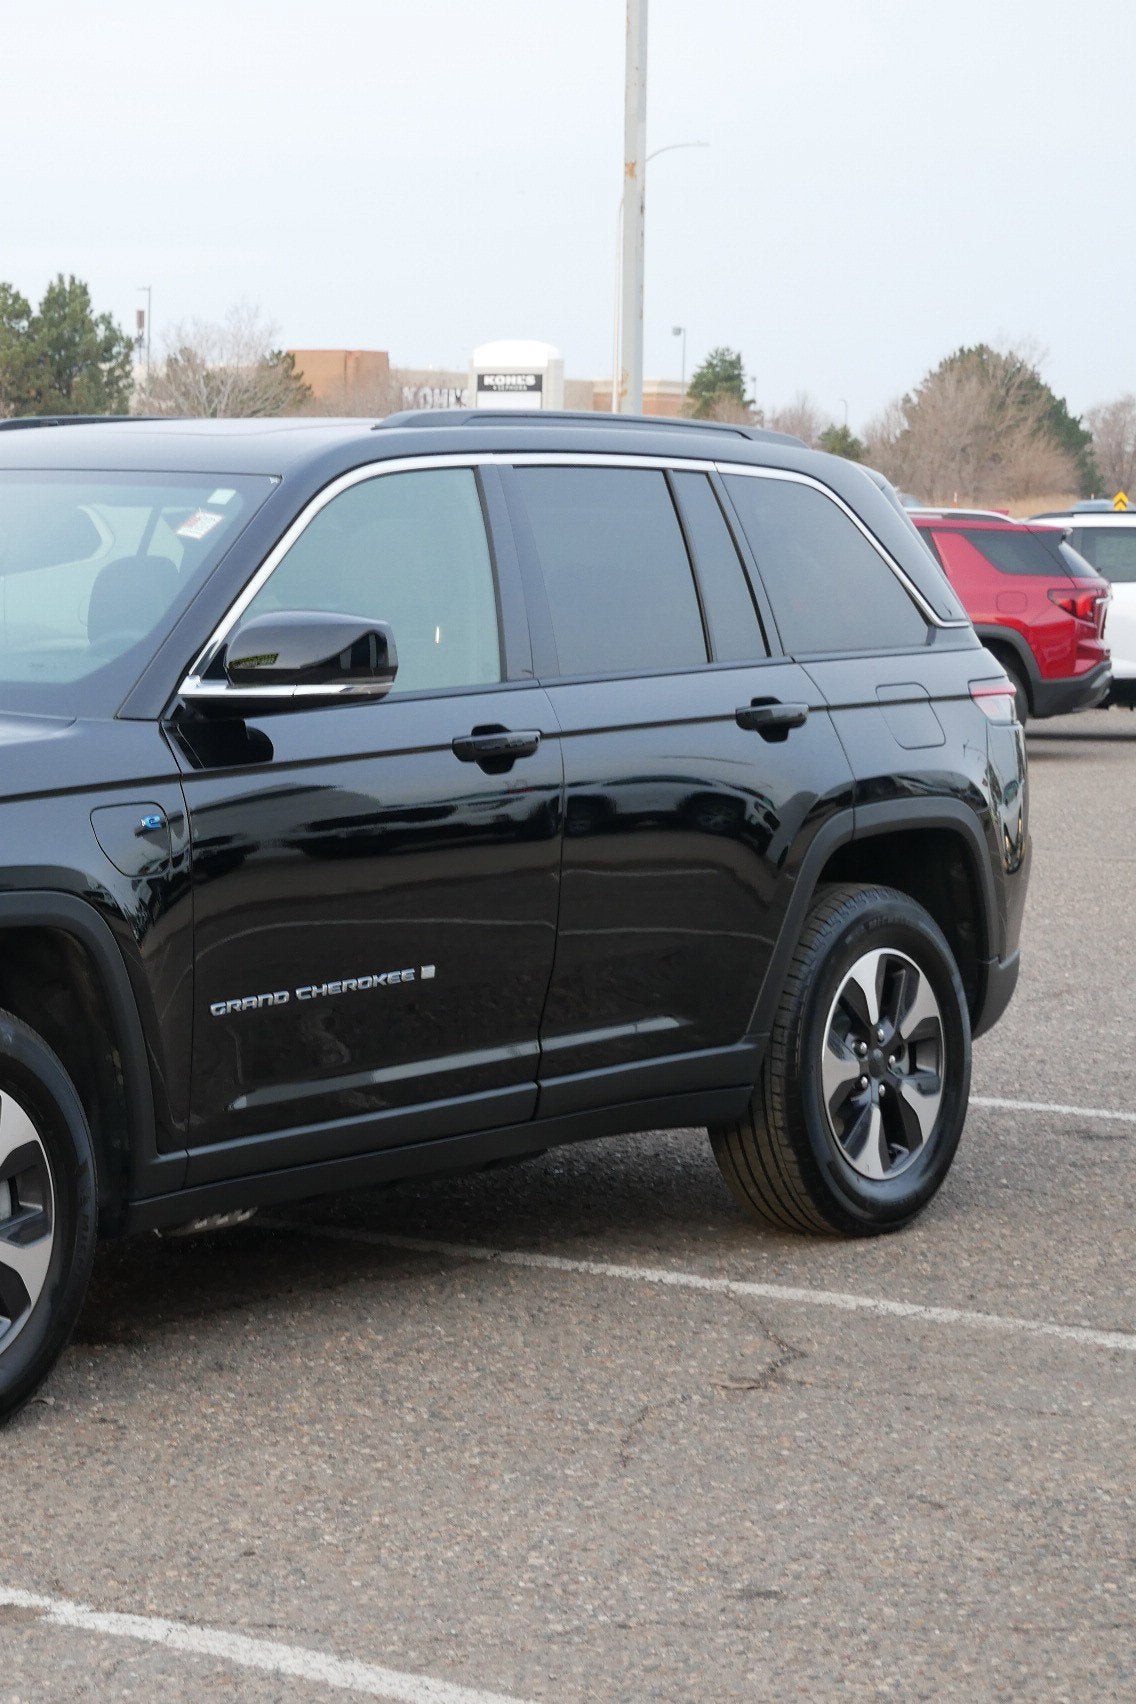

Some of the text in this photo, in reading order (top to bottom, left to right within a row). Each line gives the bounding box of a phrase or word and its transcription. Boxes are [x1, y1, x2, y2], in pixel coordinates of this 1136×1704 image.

[483, 374, 536, 386] KOHL'S
[209, 990, 290, 1017] GRAND
[295, 968, 416, 1001] CHEROKEE
